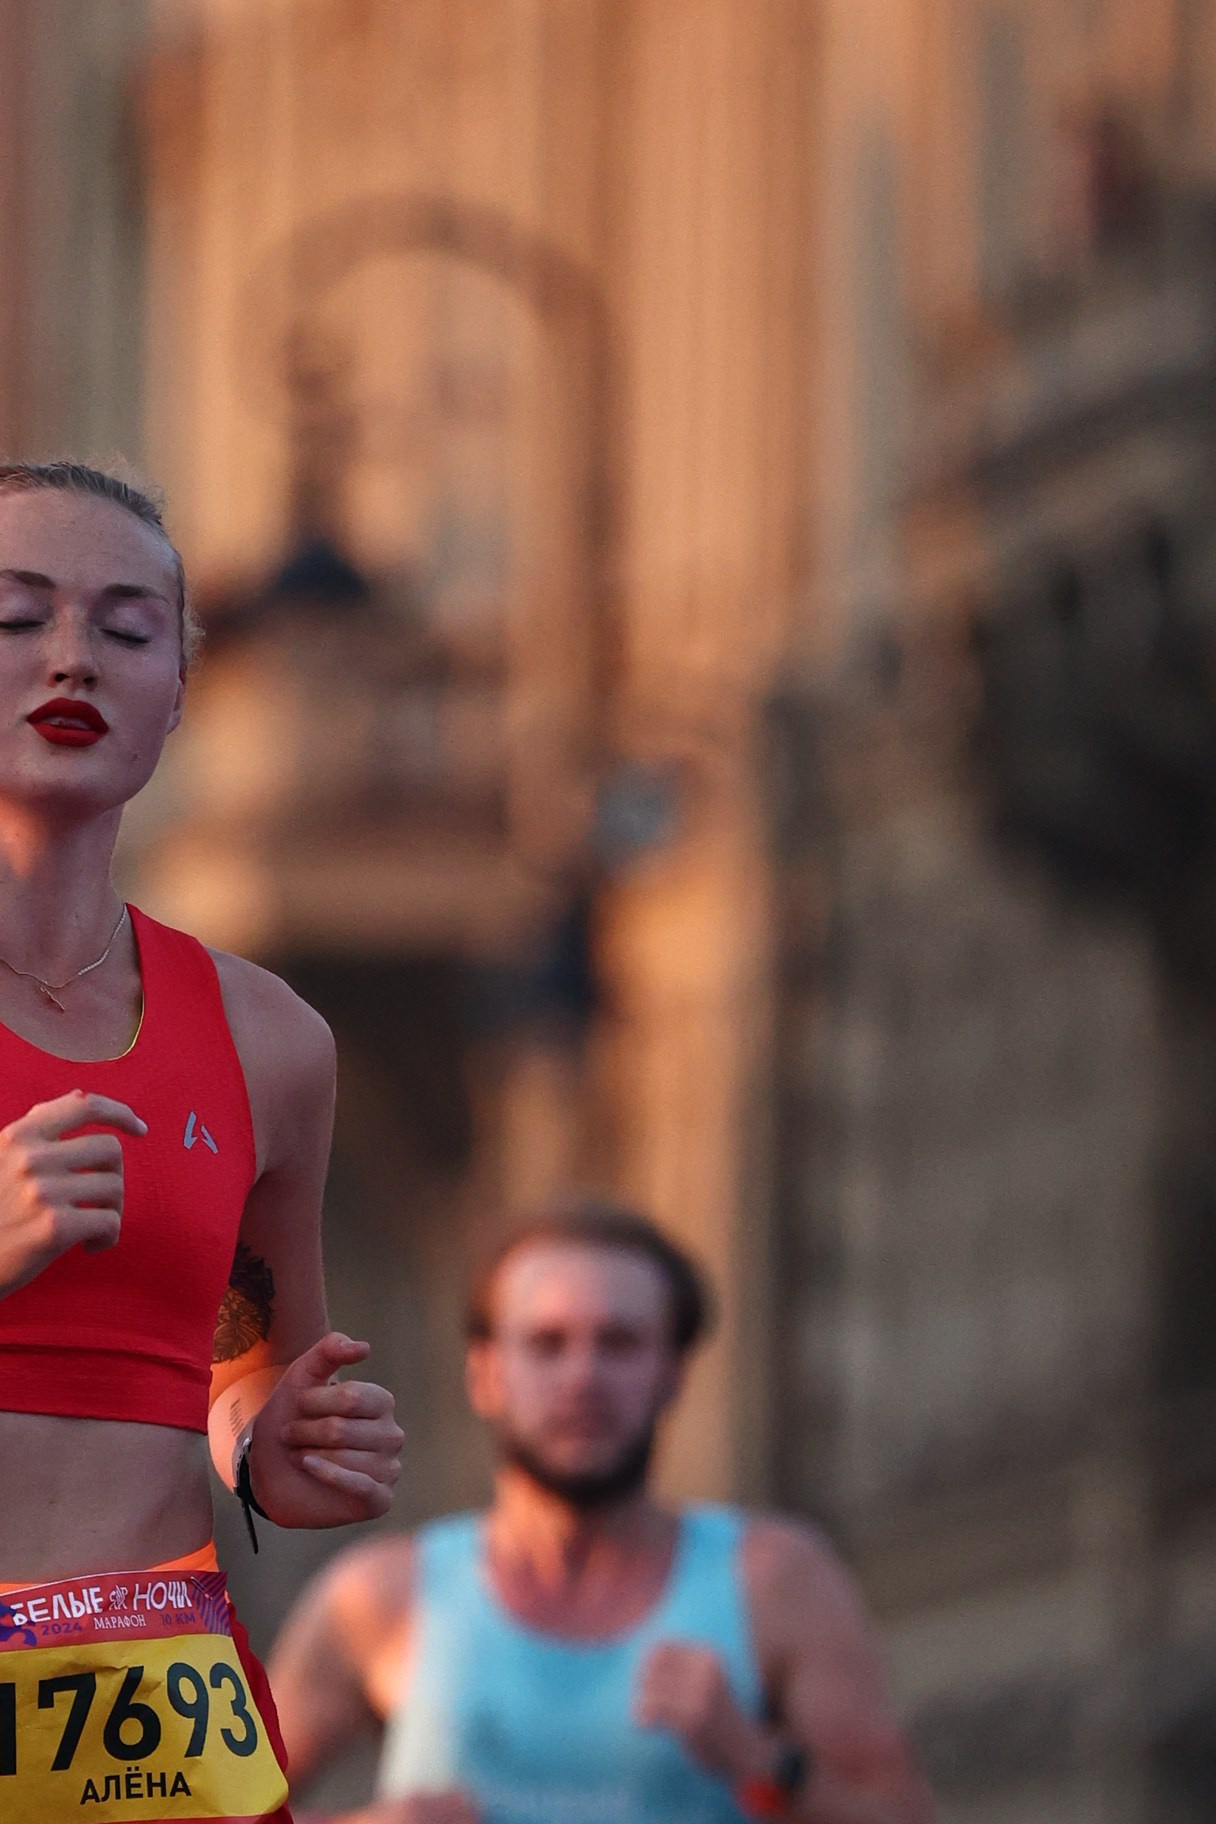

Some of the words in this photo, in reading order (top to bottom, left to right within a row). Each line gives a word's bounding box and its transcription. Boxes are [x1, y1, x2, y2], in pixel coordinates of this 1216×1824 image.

[10, 1587, 104, 1626] БЕЛЫЕ
[41, 1622, 82, 1636] 2024
[94, 1614, 146, 1630] МАРАФОН
[80, 1766, 192, 1805] АЛЁНА
